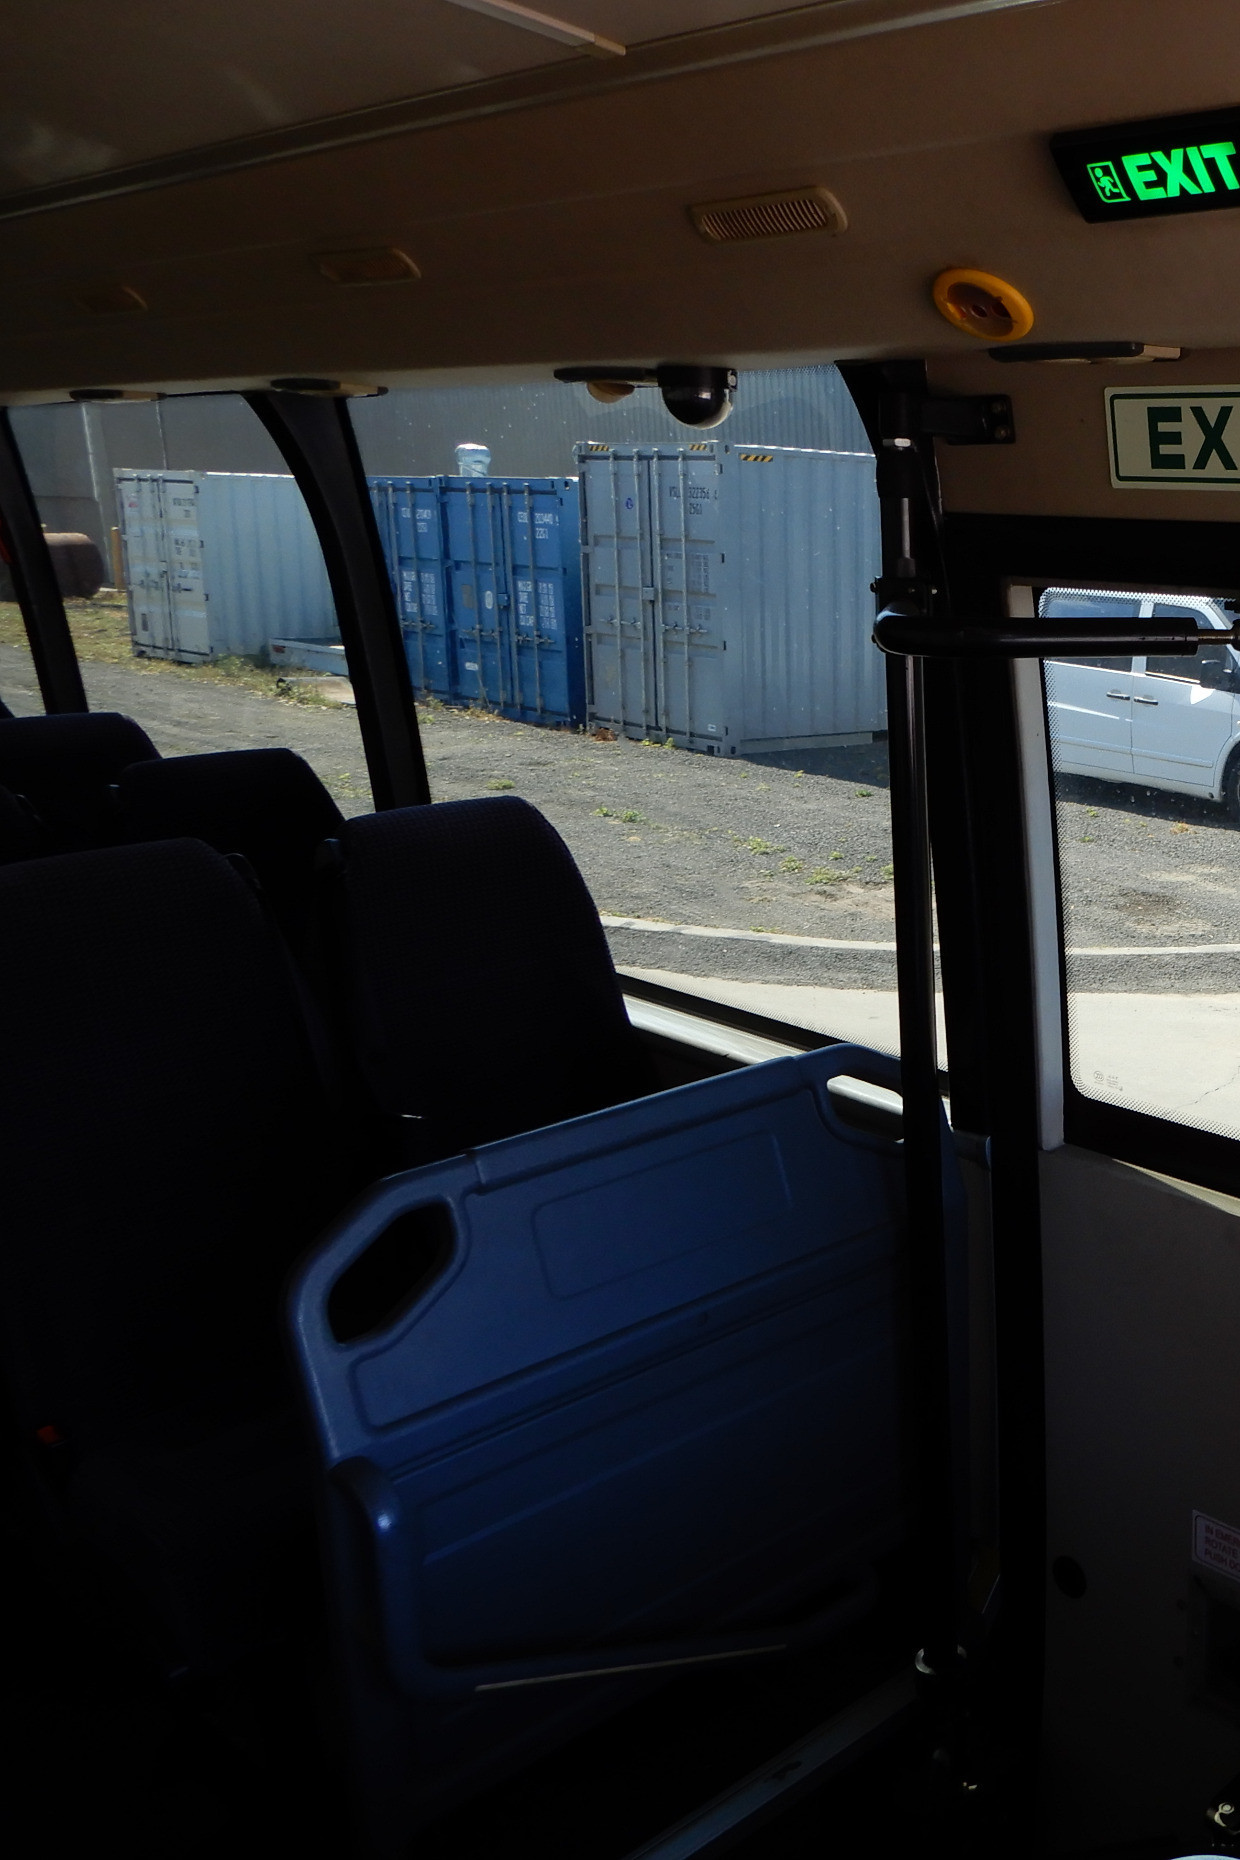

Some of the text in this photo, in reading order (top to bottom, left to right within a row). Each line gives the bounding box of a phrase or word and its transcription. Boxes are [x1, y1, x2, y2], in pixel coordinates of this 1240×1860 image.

[1205, 1524, 1213, 1534] IN
[1204, 1536, 1238, 1558] ROTATE
[1204, 1547, 1228, 1567] PUSH
